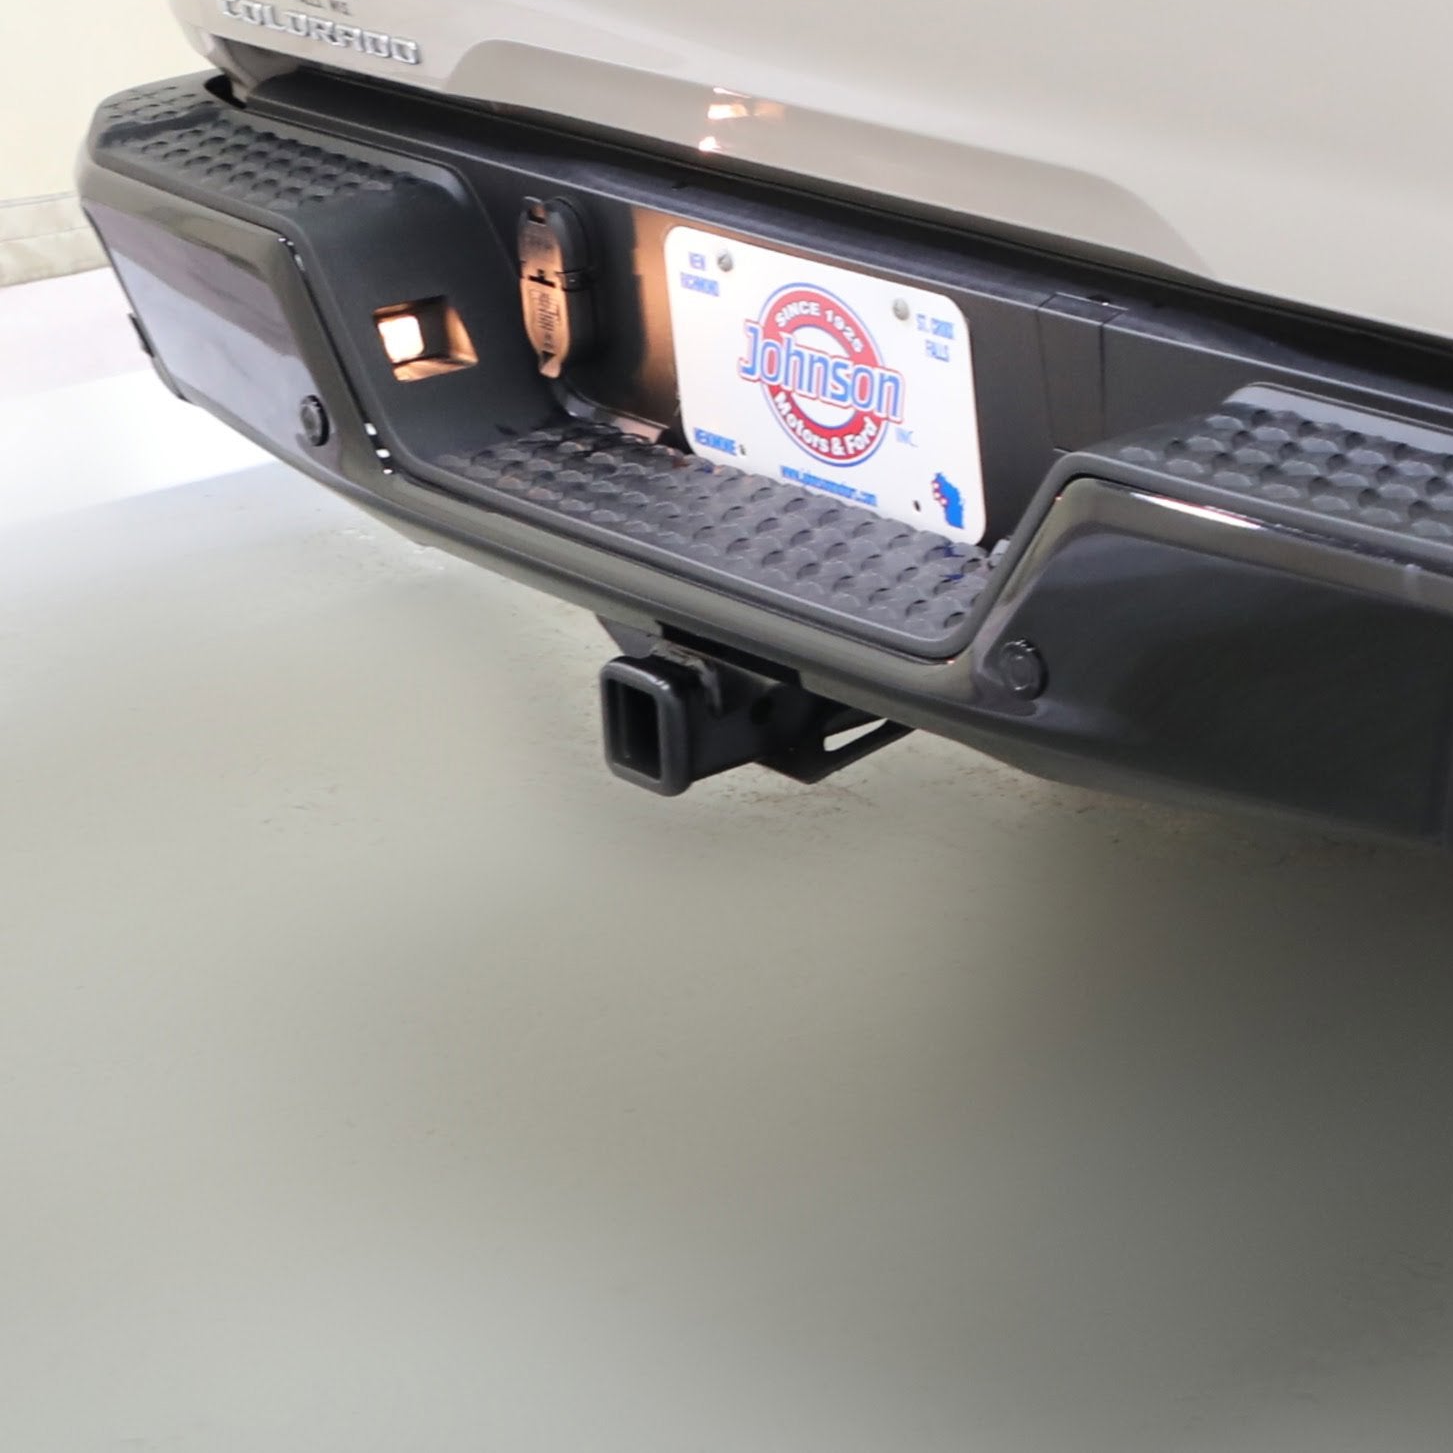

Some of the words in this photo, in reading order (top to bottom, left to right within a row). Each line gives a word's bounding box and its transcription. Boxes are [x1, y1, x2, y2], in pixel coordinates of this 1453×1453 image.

[776, 300, 821, 327] SINCE
[739, 320, 903, 422] Johnson
[775, 392, 830, 453] Motors
[843, 416, 878, 454] Ford
